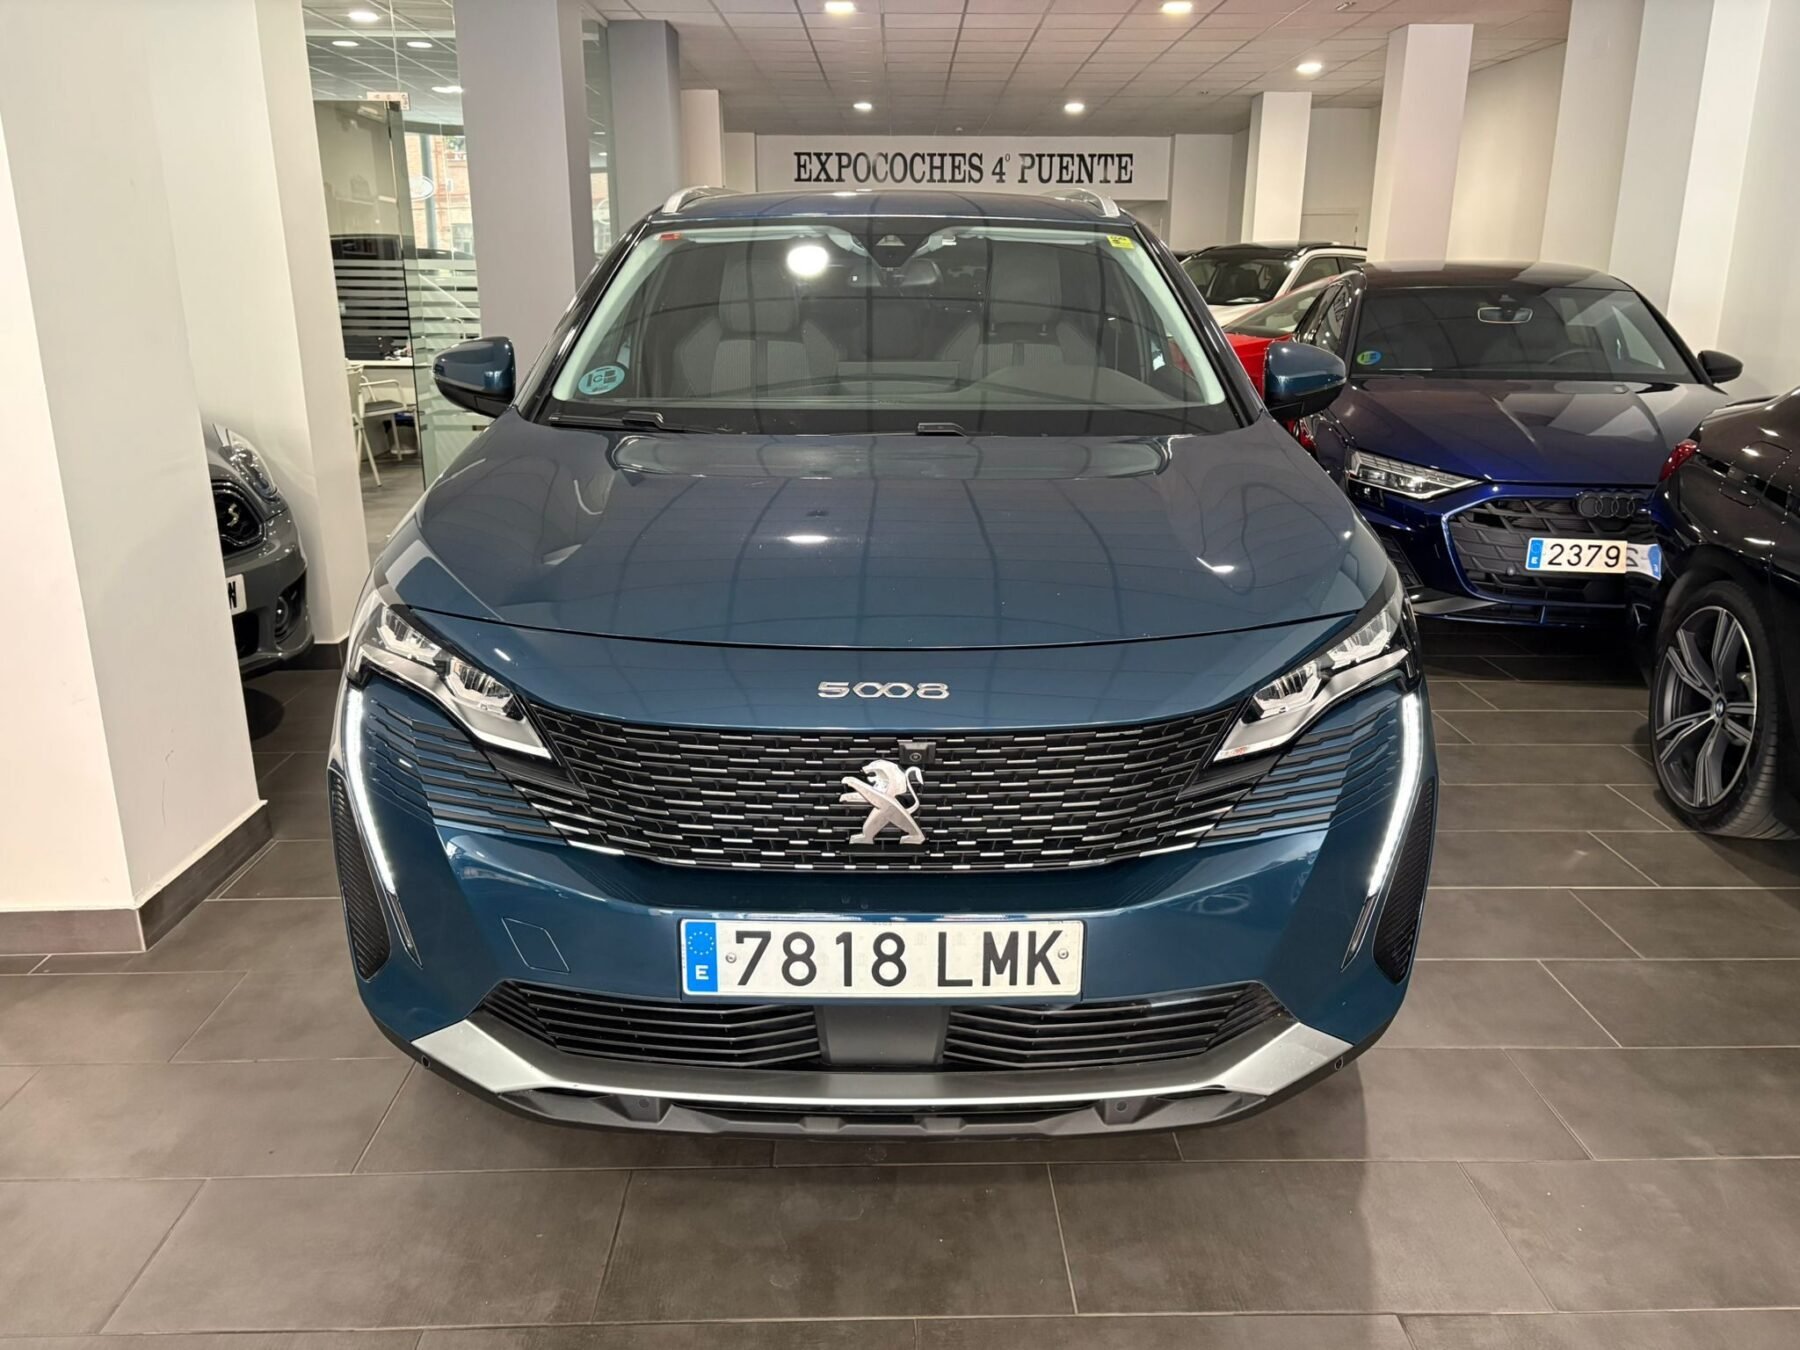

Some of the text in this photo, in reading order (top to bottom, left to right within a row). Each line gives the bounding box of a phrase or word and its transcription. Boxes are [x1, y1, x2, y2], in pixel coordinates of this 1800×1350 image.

[793, 151, 984, 184] EXPOCOCHES
[1017, 152, 1134, 184] PUENTE
[1547, 543, 1621, 569] 2379
[817, 681, 950, 699] 5008
[735, 930, 1063, 987] 7818 LMK
[695, 964, 709, 980] E
